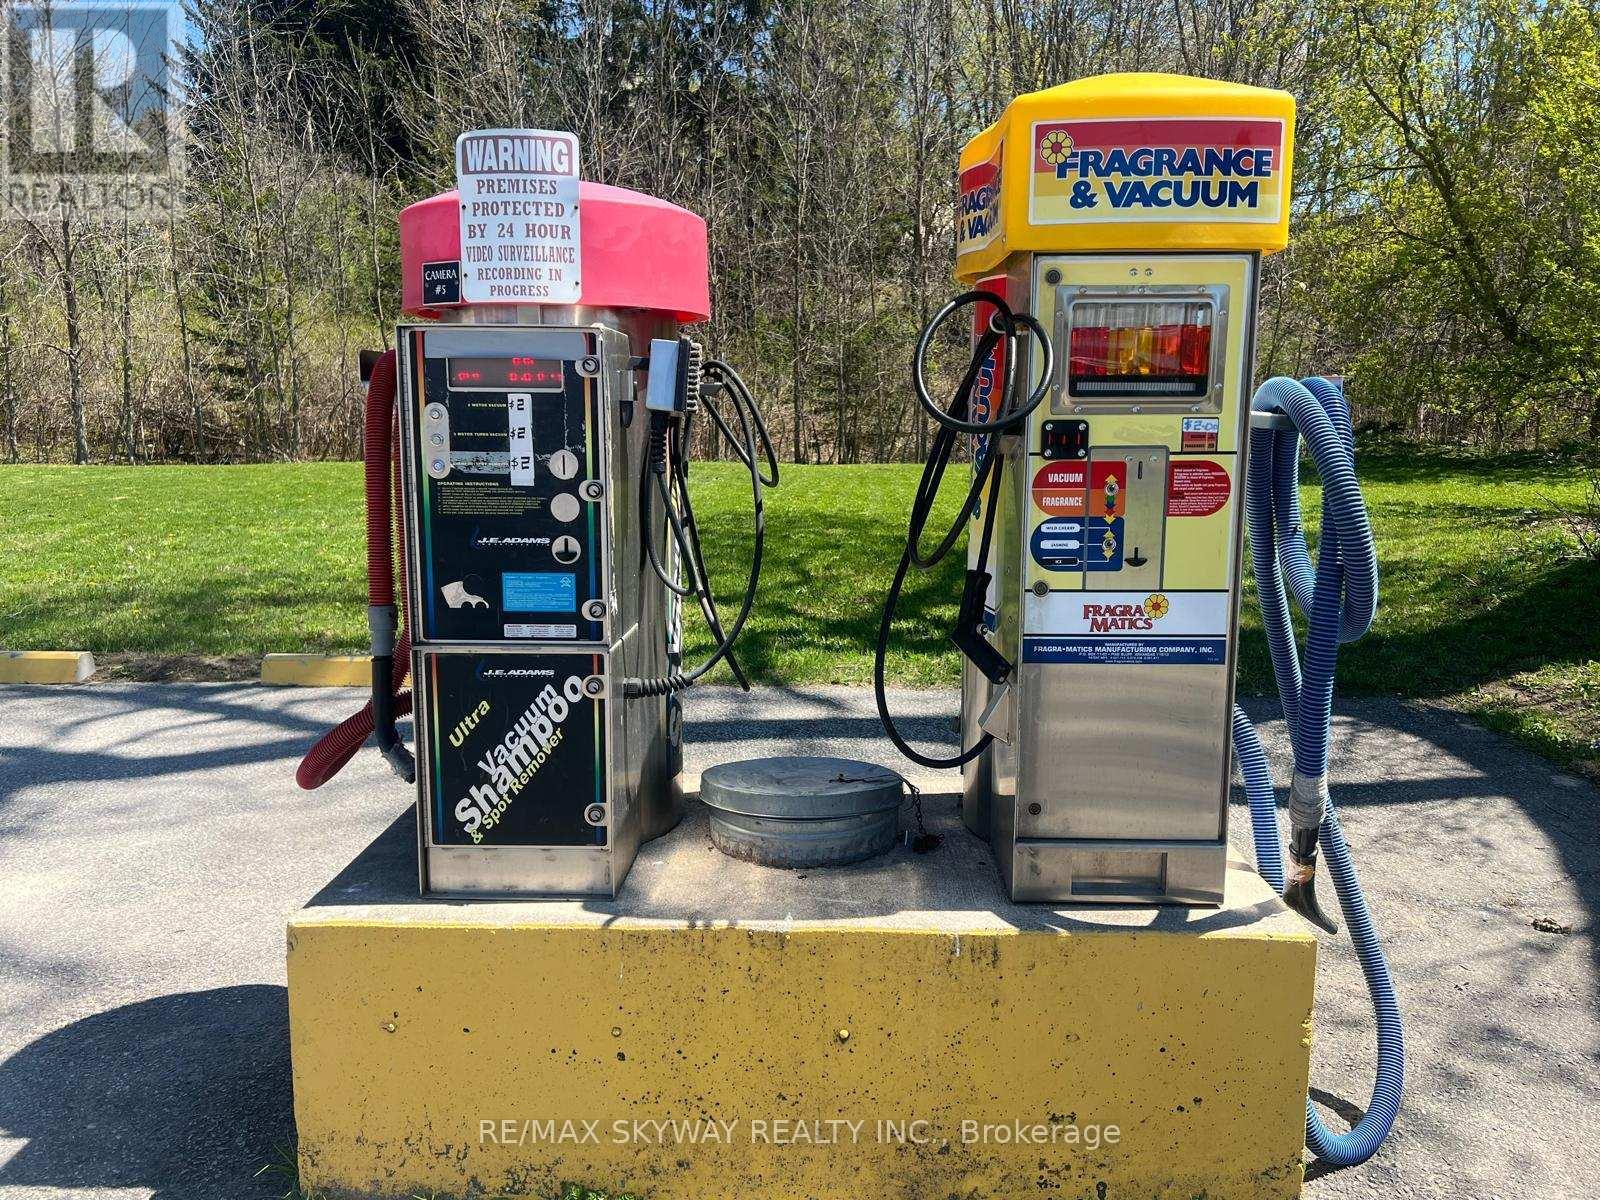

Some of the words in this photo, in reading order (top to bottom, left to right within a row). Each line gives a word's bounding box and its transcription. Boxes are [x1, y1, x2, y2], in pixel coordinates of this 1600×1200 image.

[465, 138, 569, 173] WARNING
[1056, 147, 1273, 179] FRAGRANCE
[476, 178, 558, 195] PREMISES
[1069, 179, 1099, 210] &
[1103, 180, 1259, 208] VACUUM
[472, 201, 565, 218] PROTECTED
[467, 223, 487, 239] BY
[497, 223, 514, 238] 24
[525, 223, 572, 240] HOUR
[465, 246, 493, 263] VIDEO
[498, 245, 575, 264] SURVEILLANCE
[425, 268, 458, 281] CAMERA
[477, 268, 542, 281] RECORDING
[549, 268, 562, 282] IN
[435, 285, 447, 295] #5
[489, 285, 550, 297] PROGRESS
[1047, 473, 1083, 483] VACUUM
[1042, 497, 1083, 507] FRAGRANCE
[1083, 604, 1145, 619] FRAGRA
[1089, 617, 1154, 632] MATICS
[1159, 646, 1198, 654] COMPANY,
[448, 700, 491, 748] Ultra
[477, 683, 558, 777] Vacuum
[454, 675, 584, 834] Shampoo
[470, 828, 484, 844] &
[481, 793, 513, 830] Spot
[509, 726, 564, 796] Remover
